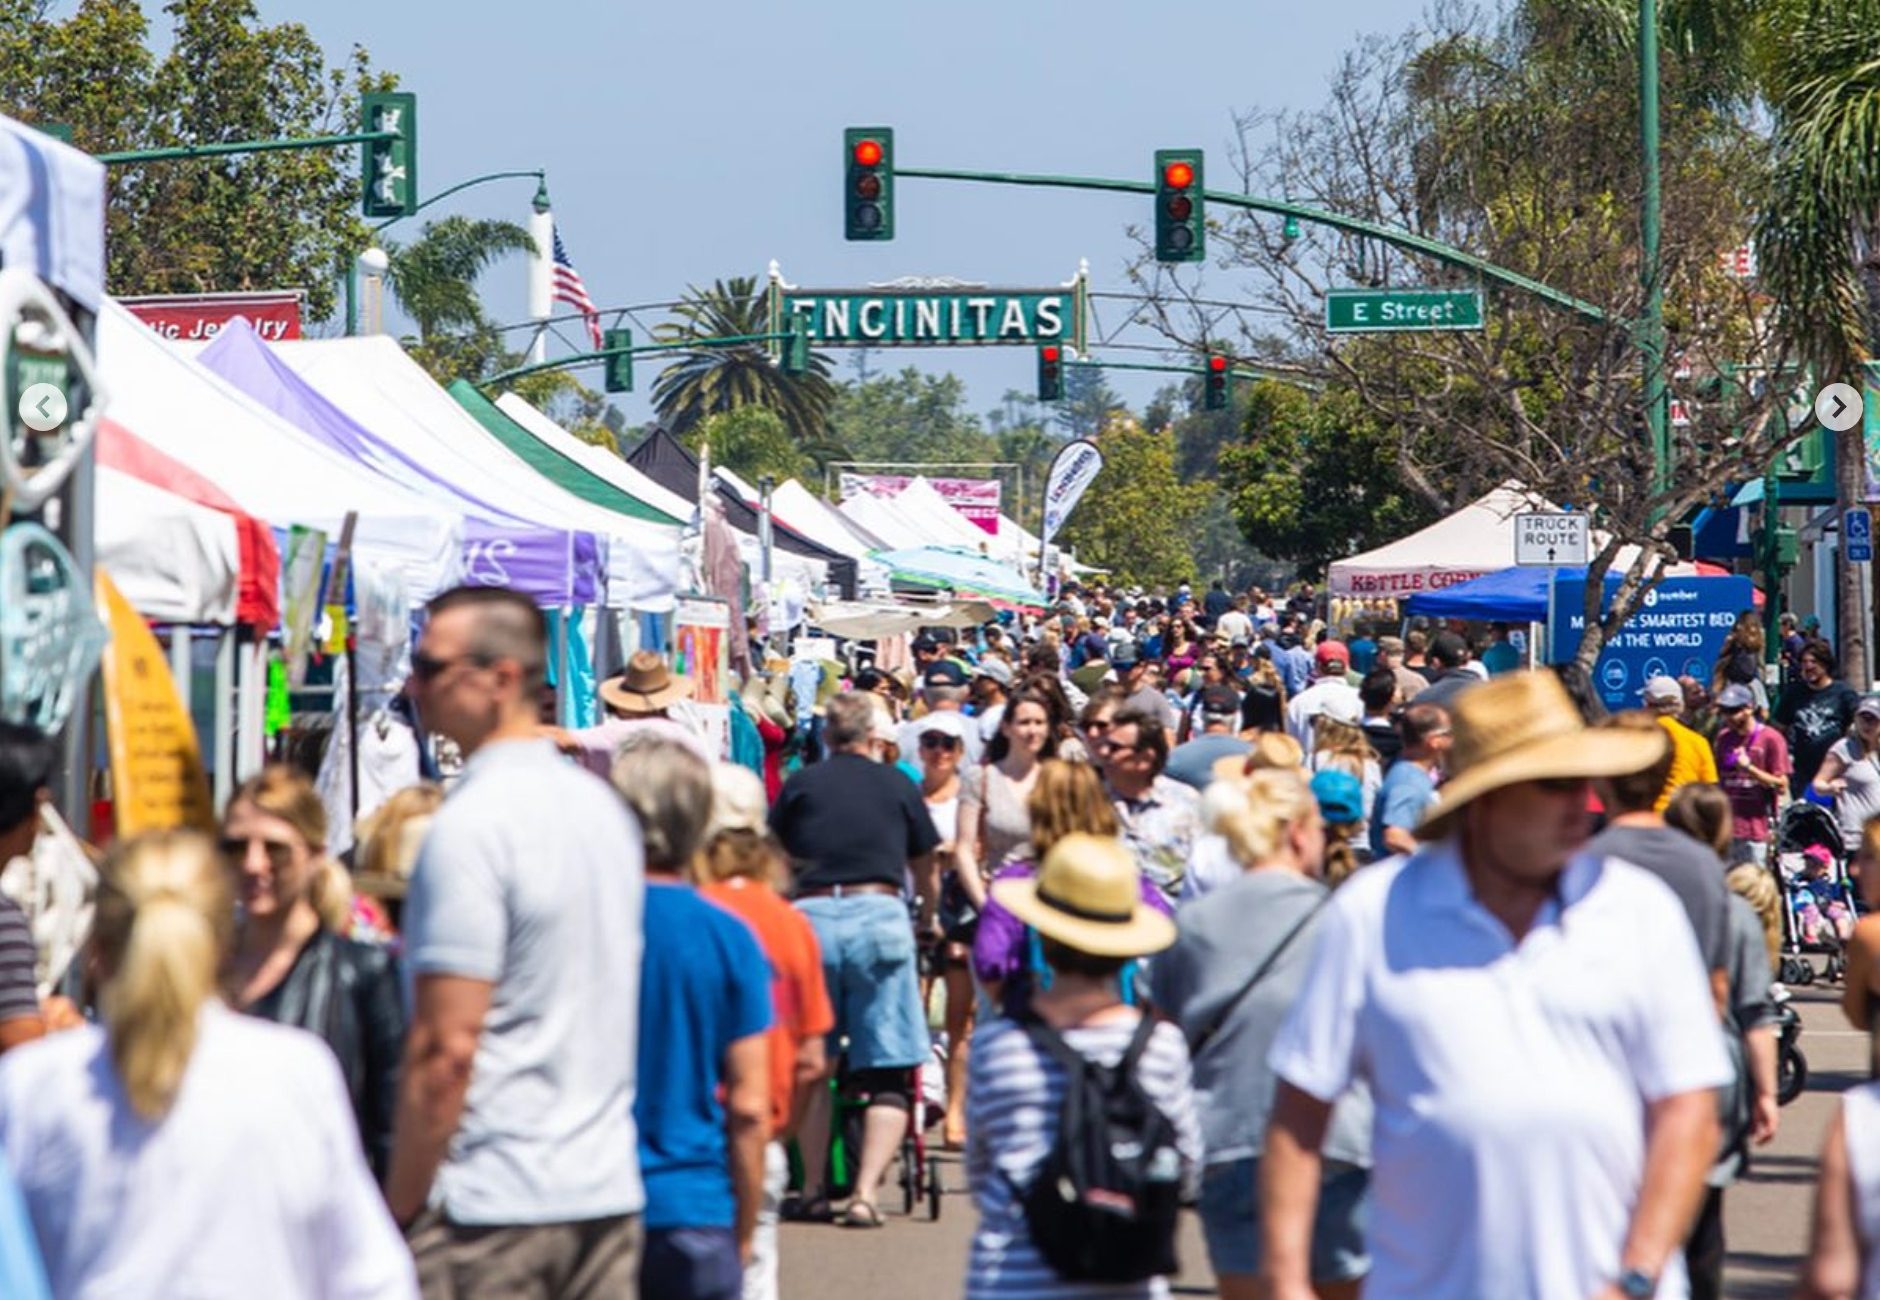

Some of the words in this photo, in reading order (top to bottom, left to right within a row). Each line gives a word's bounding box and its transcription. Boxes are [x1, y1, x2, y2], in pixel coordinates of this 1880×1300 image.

[792, 298, 1063, 338] ENCINITAS
[1353, 302, 1368, 321] E
[1381, 301, 1454, 321] Street
[1524, 518, 1579, 530] TRUCK
[1524, 532, 1579, 545] ROUTE
[1351, 573, 1423, 592] KETTLE
[1659, 588, 1698, 601] number
[1640, 613, 1705, 628] SMARTEST
[1708, 611, 1737, 628] BED
[1624, 633, 1652, 648] THE
[1652, 632, 1703, 647] WORLD
